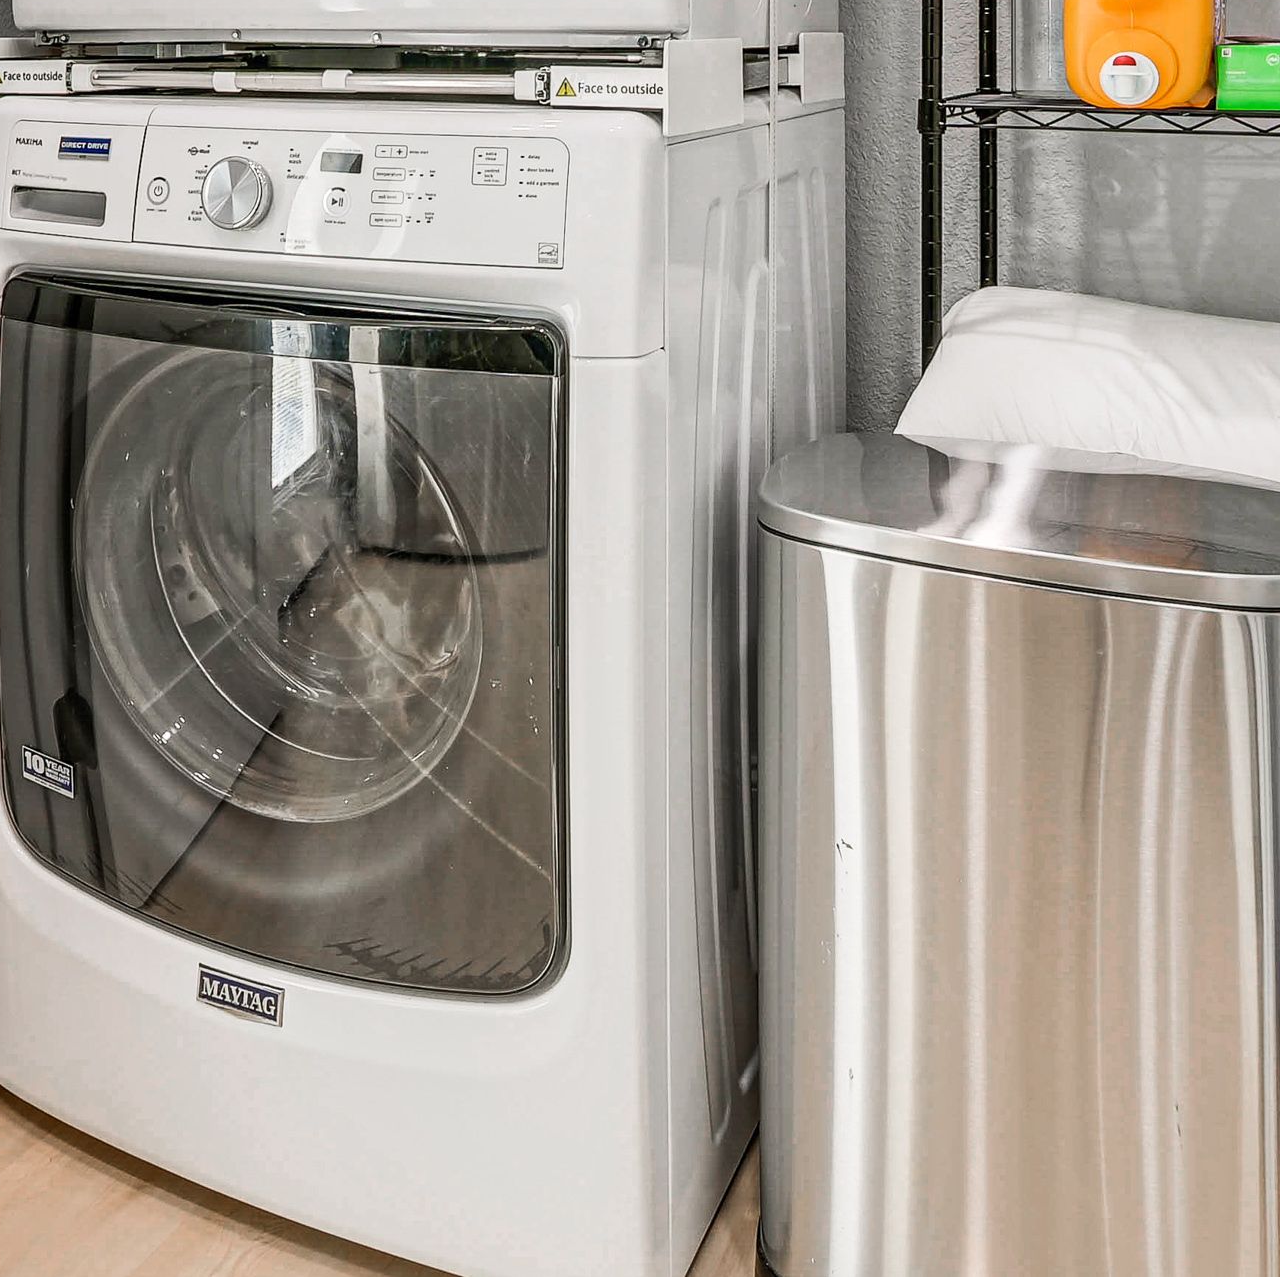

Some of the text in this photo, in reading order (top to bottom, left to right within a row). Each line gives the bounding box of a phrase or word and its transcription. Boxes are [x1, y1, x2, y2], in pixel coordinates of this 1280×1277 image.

[3, 71, 63, 81] Face to outside
[578, 82, 664, 95] Face to outside
[25, 751, 45, 774] 10
[45, 759, 70, 776] YEAR
[201, 976, 276, 1016] MAYTAG
